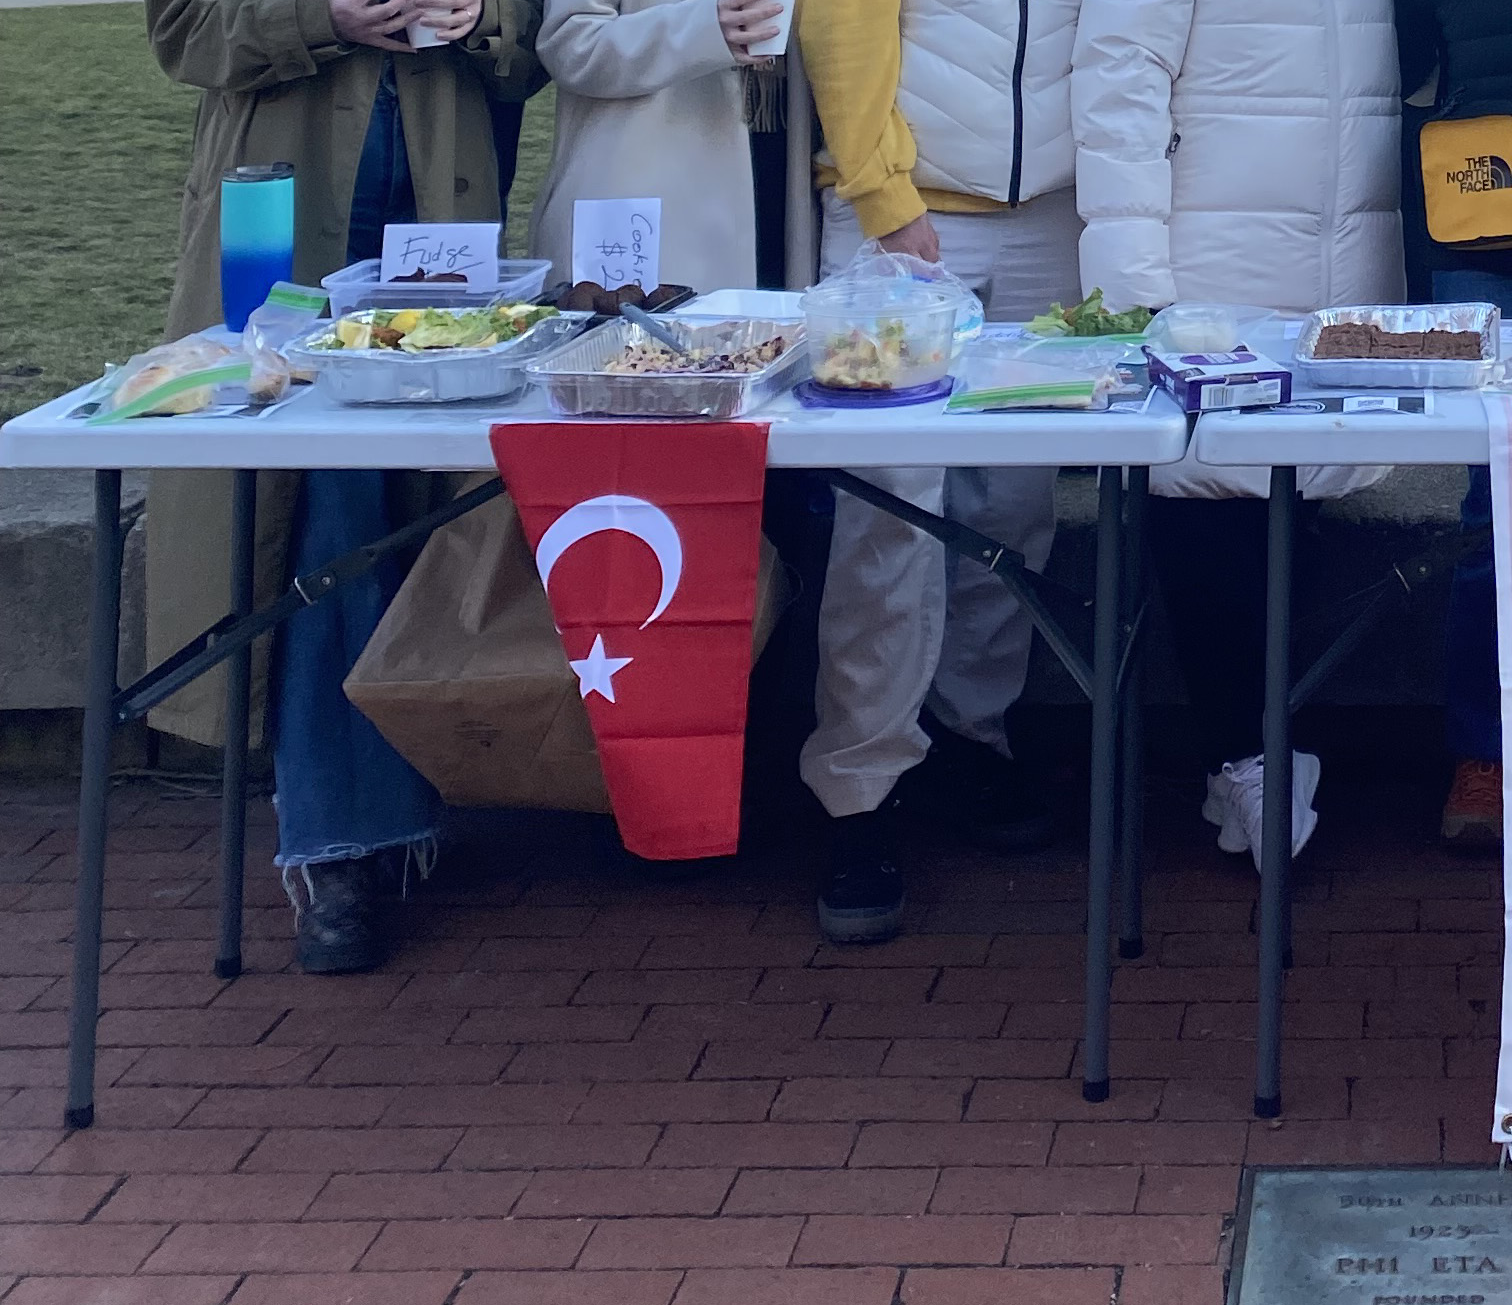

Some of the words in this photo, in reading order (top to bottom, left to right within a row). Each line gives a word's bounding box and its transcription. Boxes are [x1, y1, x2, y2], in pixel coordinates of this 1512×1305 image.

[1464, 156, 1490, 169] THE
[1446, 169, 1491, 184] NORTH
[1459, 180, 1491, 194] FACE
[400, 236, 474, 268] Fudge
[1335, 1256, 1400, 1274] PHI
[1432, 1255, 1504, 1274] ETA
